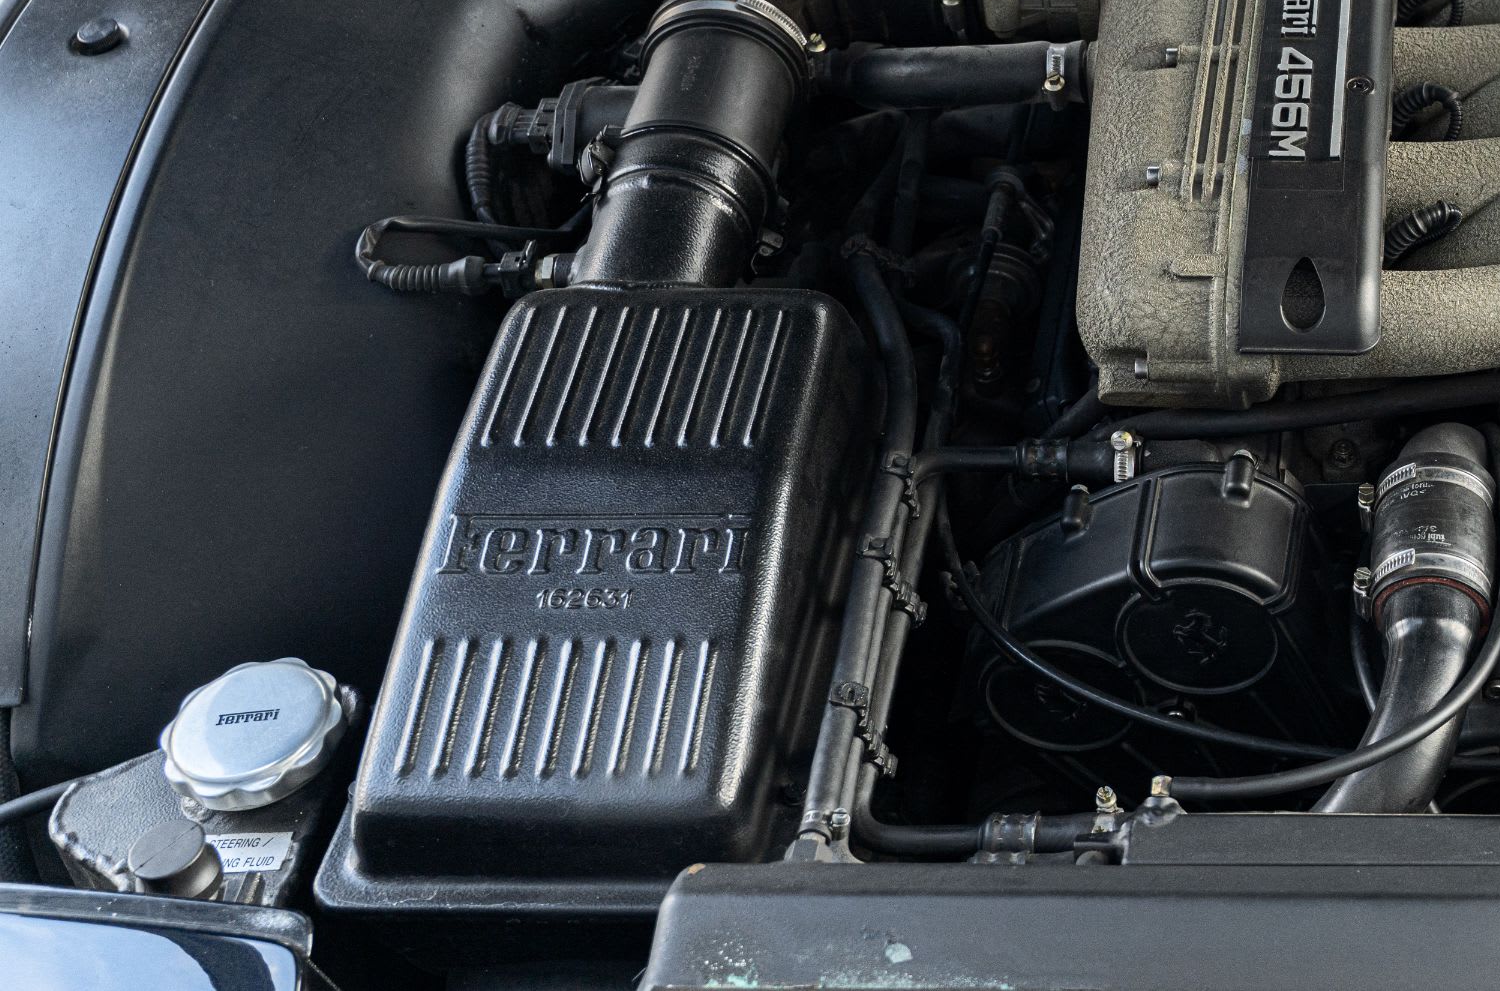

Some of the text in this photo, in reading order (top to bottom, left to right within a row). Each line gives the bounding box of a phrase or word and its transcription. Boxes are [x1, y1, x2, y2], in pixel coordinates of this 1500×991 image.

[1268, 46, 1314, 161] 456M
[436, 513, 752, 575] Ferrari
[536, 588, 635, 610] 162631
[216, 708, 281, 726] Ferrari
[243, 856, 275, 868] FLUID
